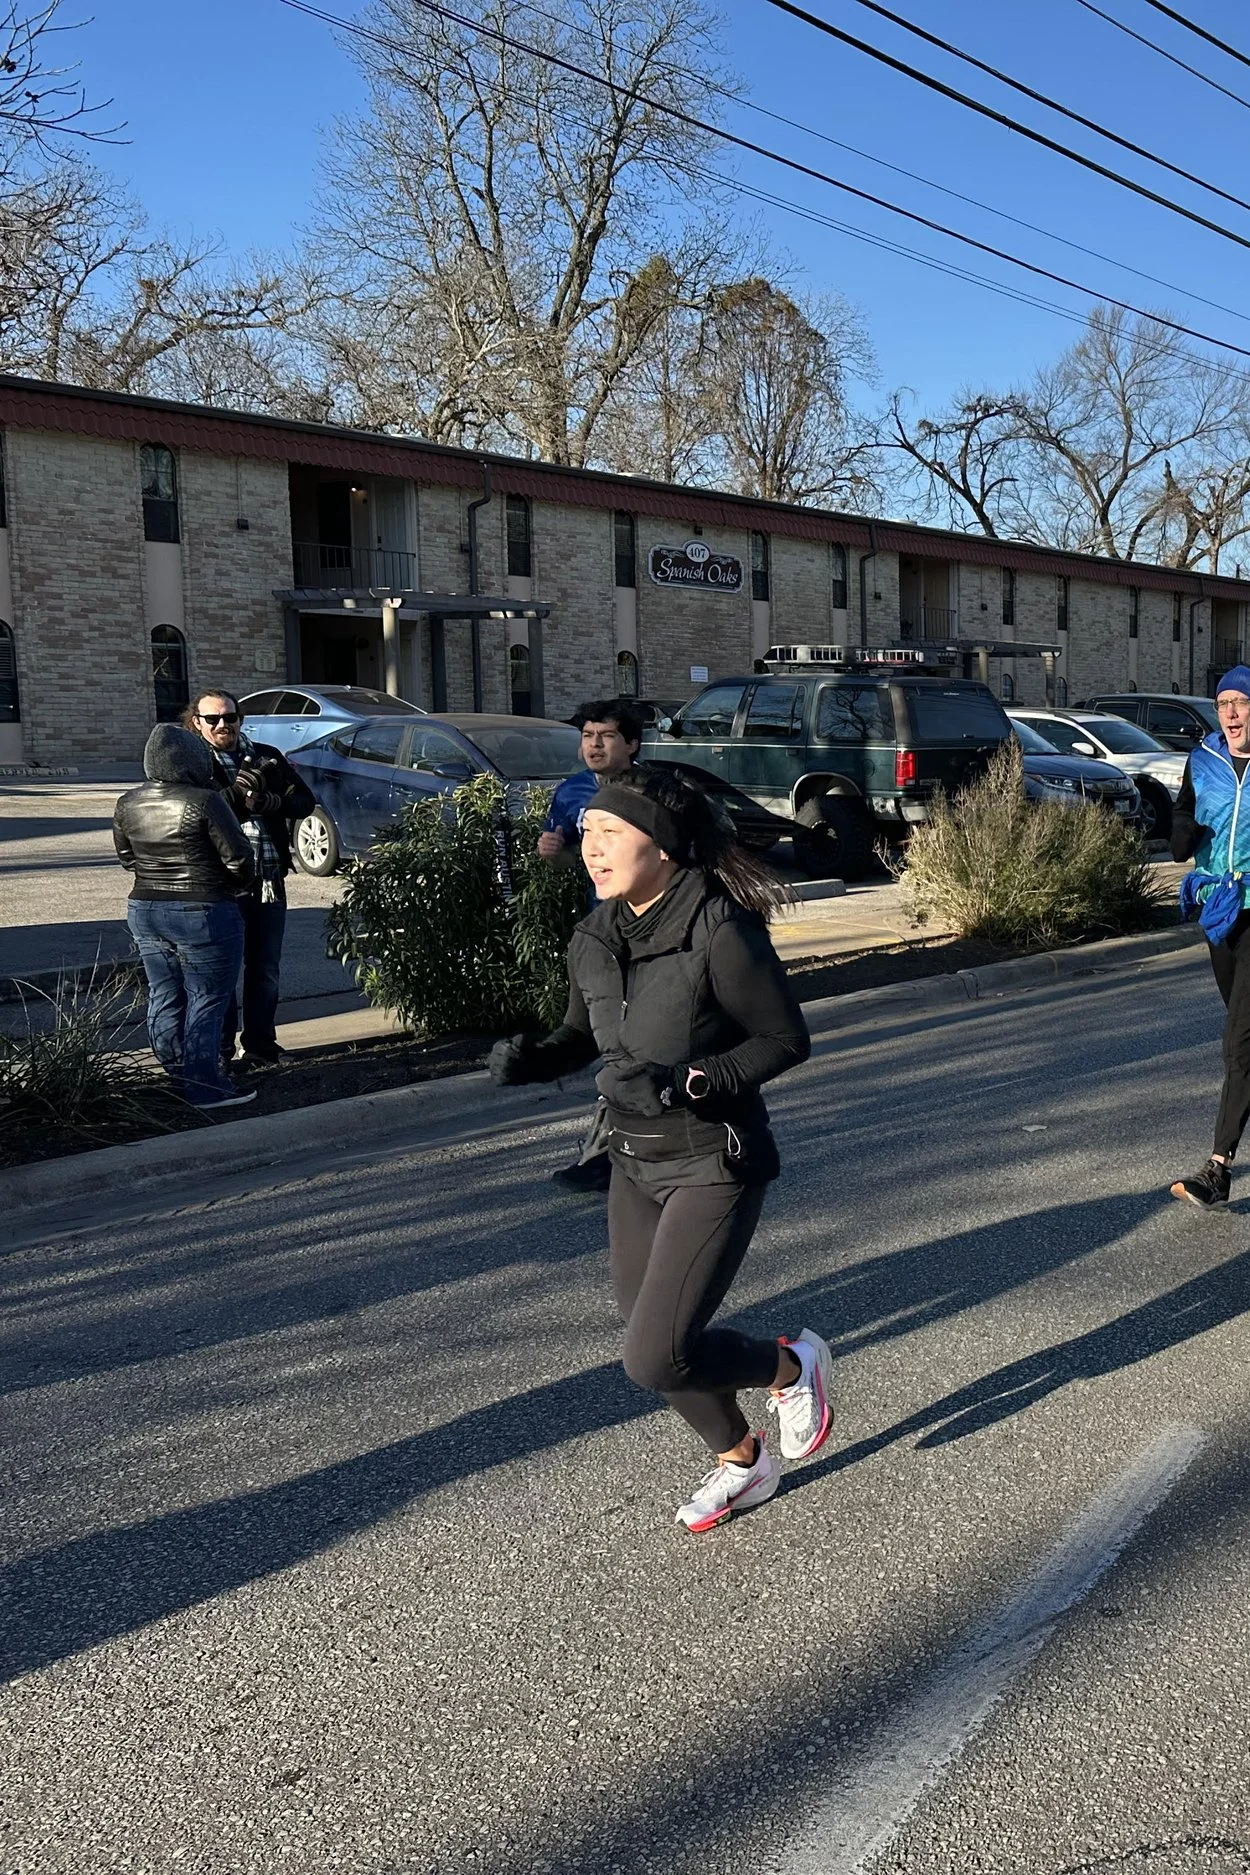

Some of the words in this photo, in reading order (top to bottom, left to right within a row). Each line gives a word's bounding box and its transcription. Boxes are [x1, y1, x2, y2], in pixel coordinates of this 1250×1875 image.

[688, 547, 706, 559] 407
[657, 558, 705, 582] Spanish
[707, 564, 739, 585] Oaks
[495, 830, 507, 857] RUN
